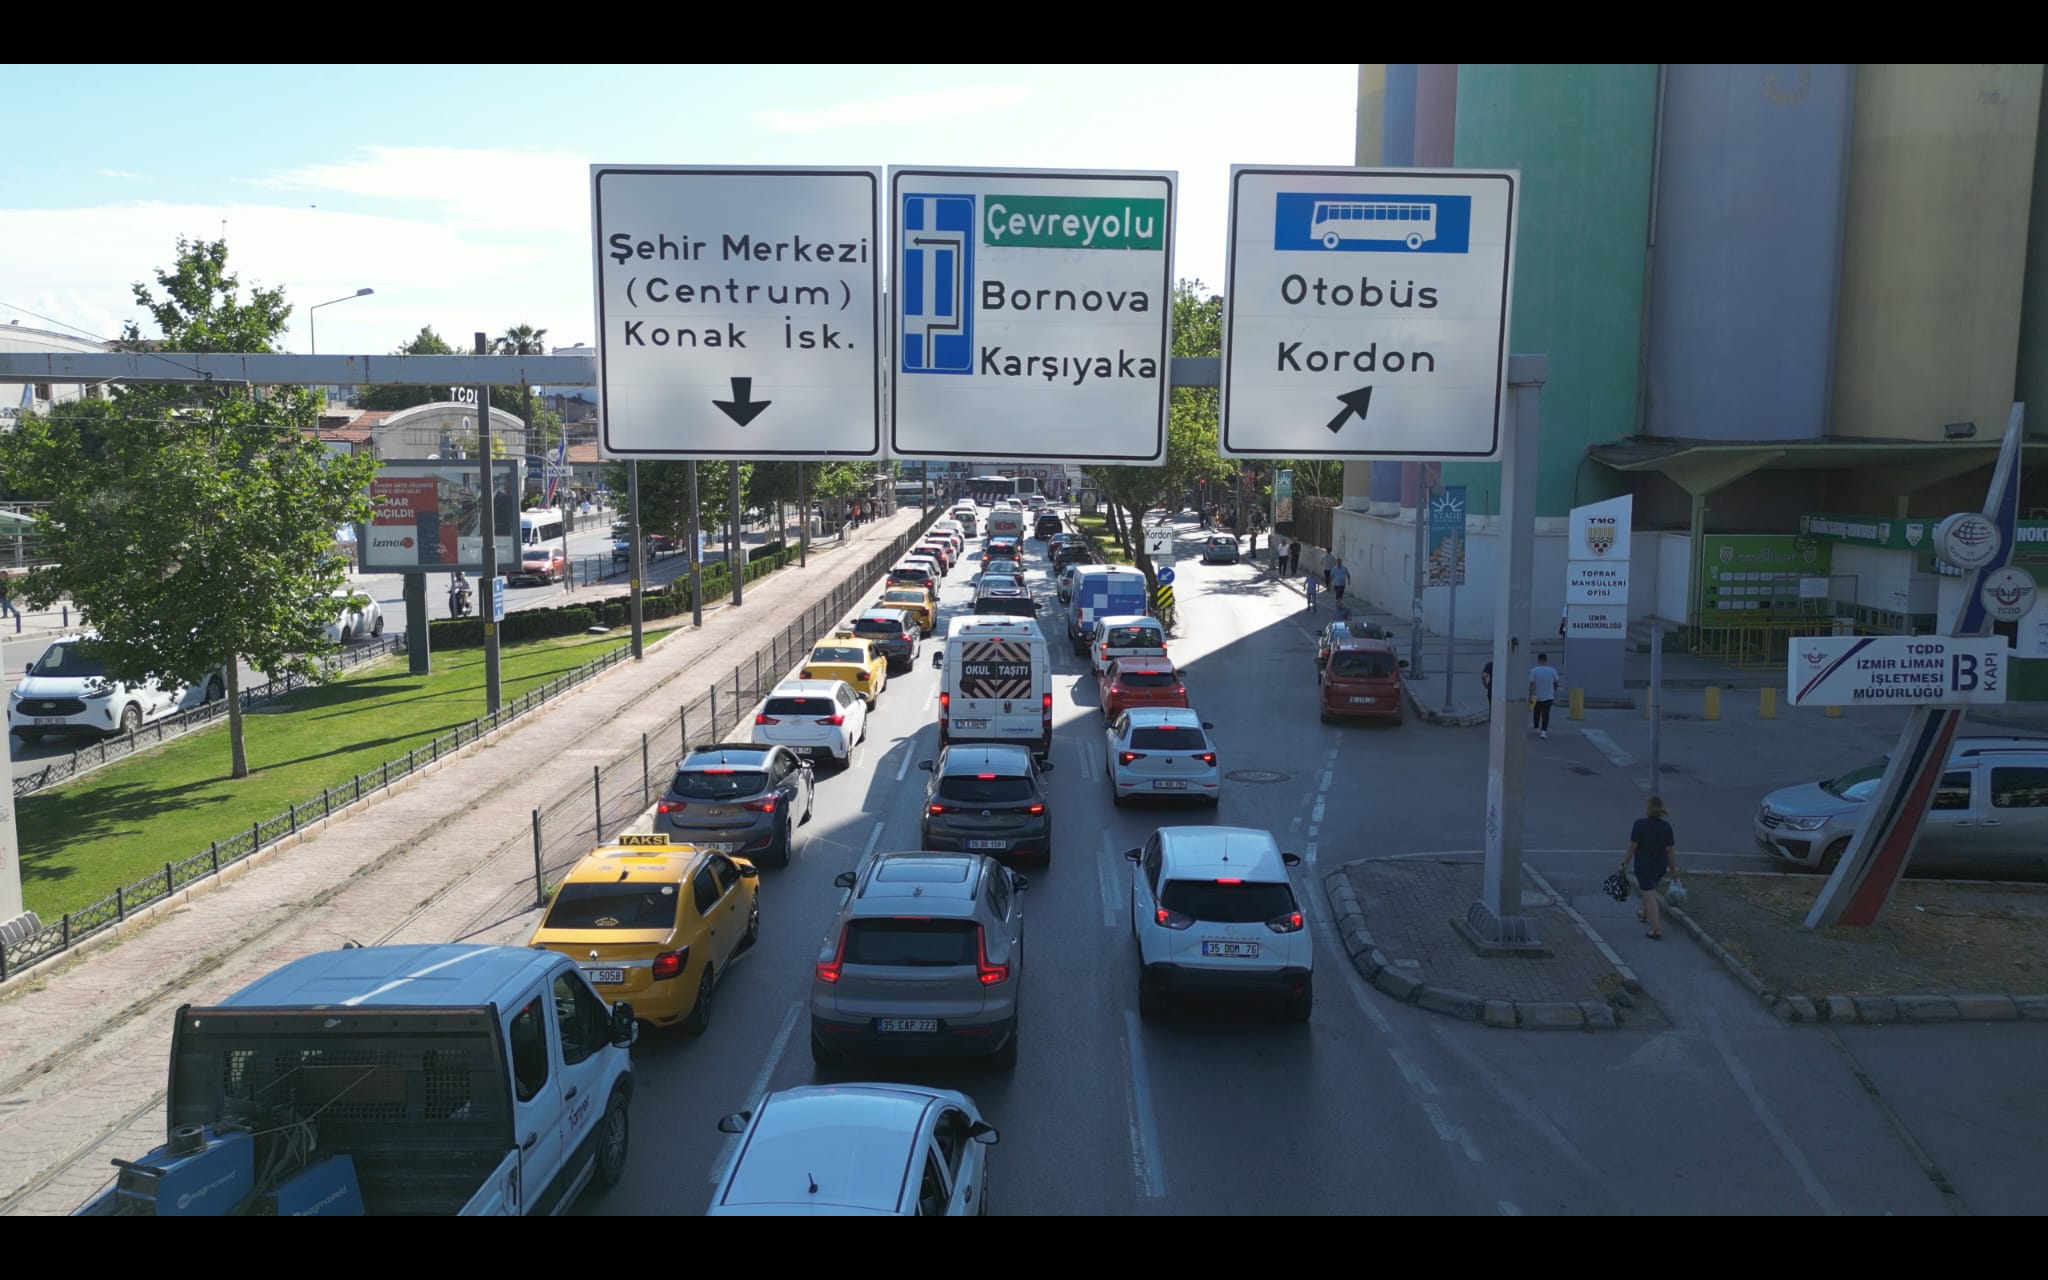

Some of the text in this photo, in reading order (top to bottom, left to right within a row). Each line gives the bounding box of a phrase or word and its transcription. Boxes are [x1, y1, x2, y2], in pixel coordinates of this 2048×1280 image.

[987, 203, 1154, 246] Çevreyolu
[609, 233, 868, 265] Şehir Merkezi
[626, 276, 852, 311] (Centrum)
[982, 280, 1149, 312] Bornova
[1281, 274, 1438, 309] Otobüs
[624, 315, 854, 349] Konak İsk.
[981, 346, 1157, 386] Karşıyaka
[1277, 341, 1434, 372] Kordon
[1145, 529, 1172, 539] Kordon
[1857, 657, 1944, 670] İZMİR LİMAN
[1907, 644, 1945, 655] TCDD
[965, 665, 1029, 677] OKUL TAŞITI
[1871, 672, 1944, 684] İŞLETMESİ
[1951, 653, 1979, 692] B
[1983, 652, 1998, 691] KAPI
[1853, 686, 1944, 698] MÜDÜRLÜĞÜ
[1209, 944, 1220, 953] 35
[599, 971, 621, 981] 5058
[882, 1020, 895, 1030] 35
